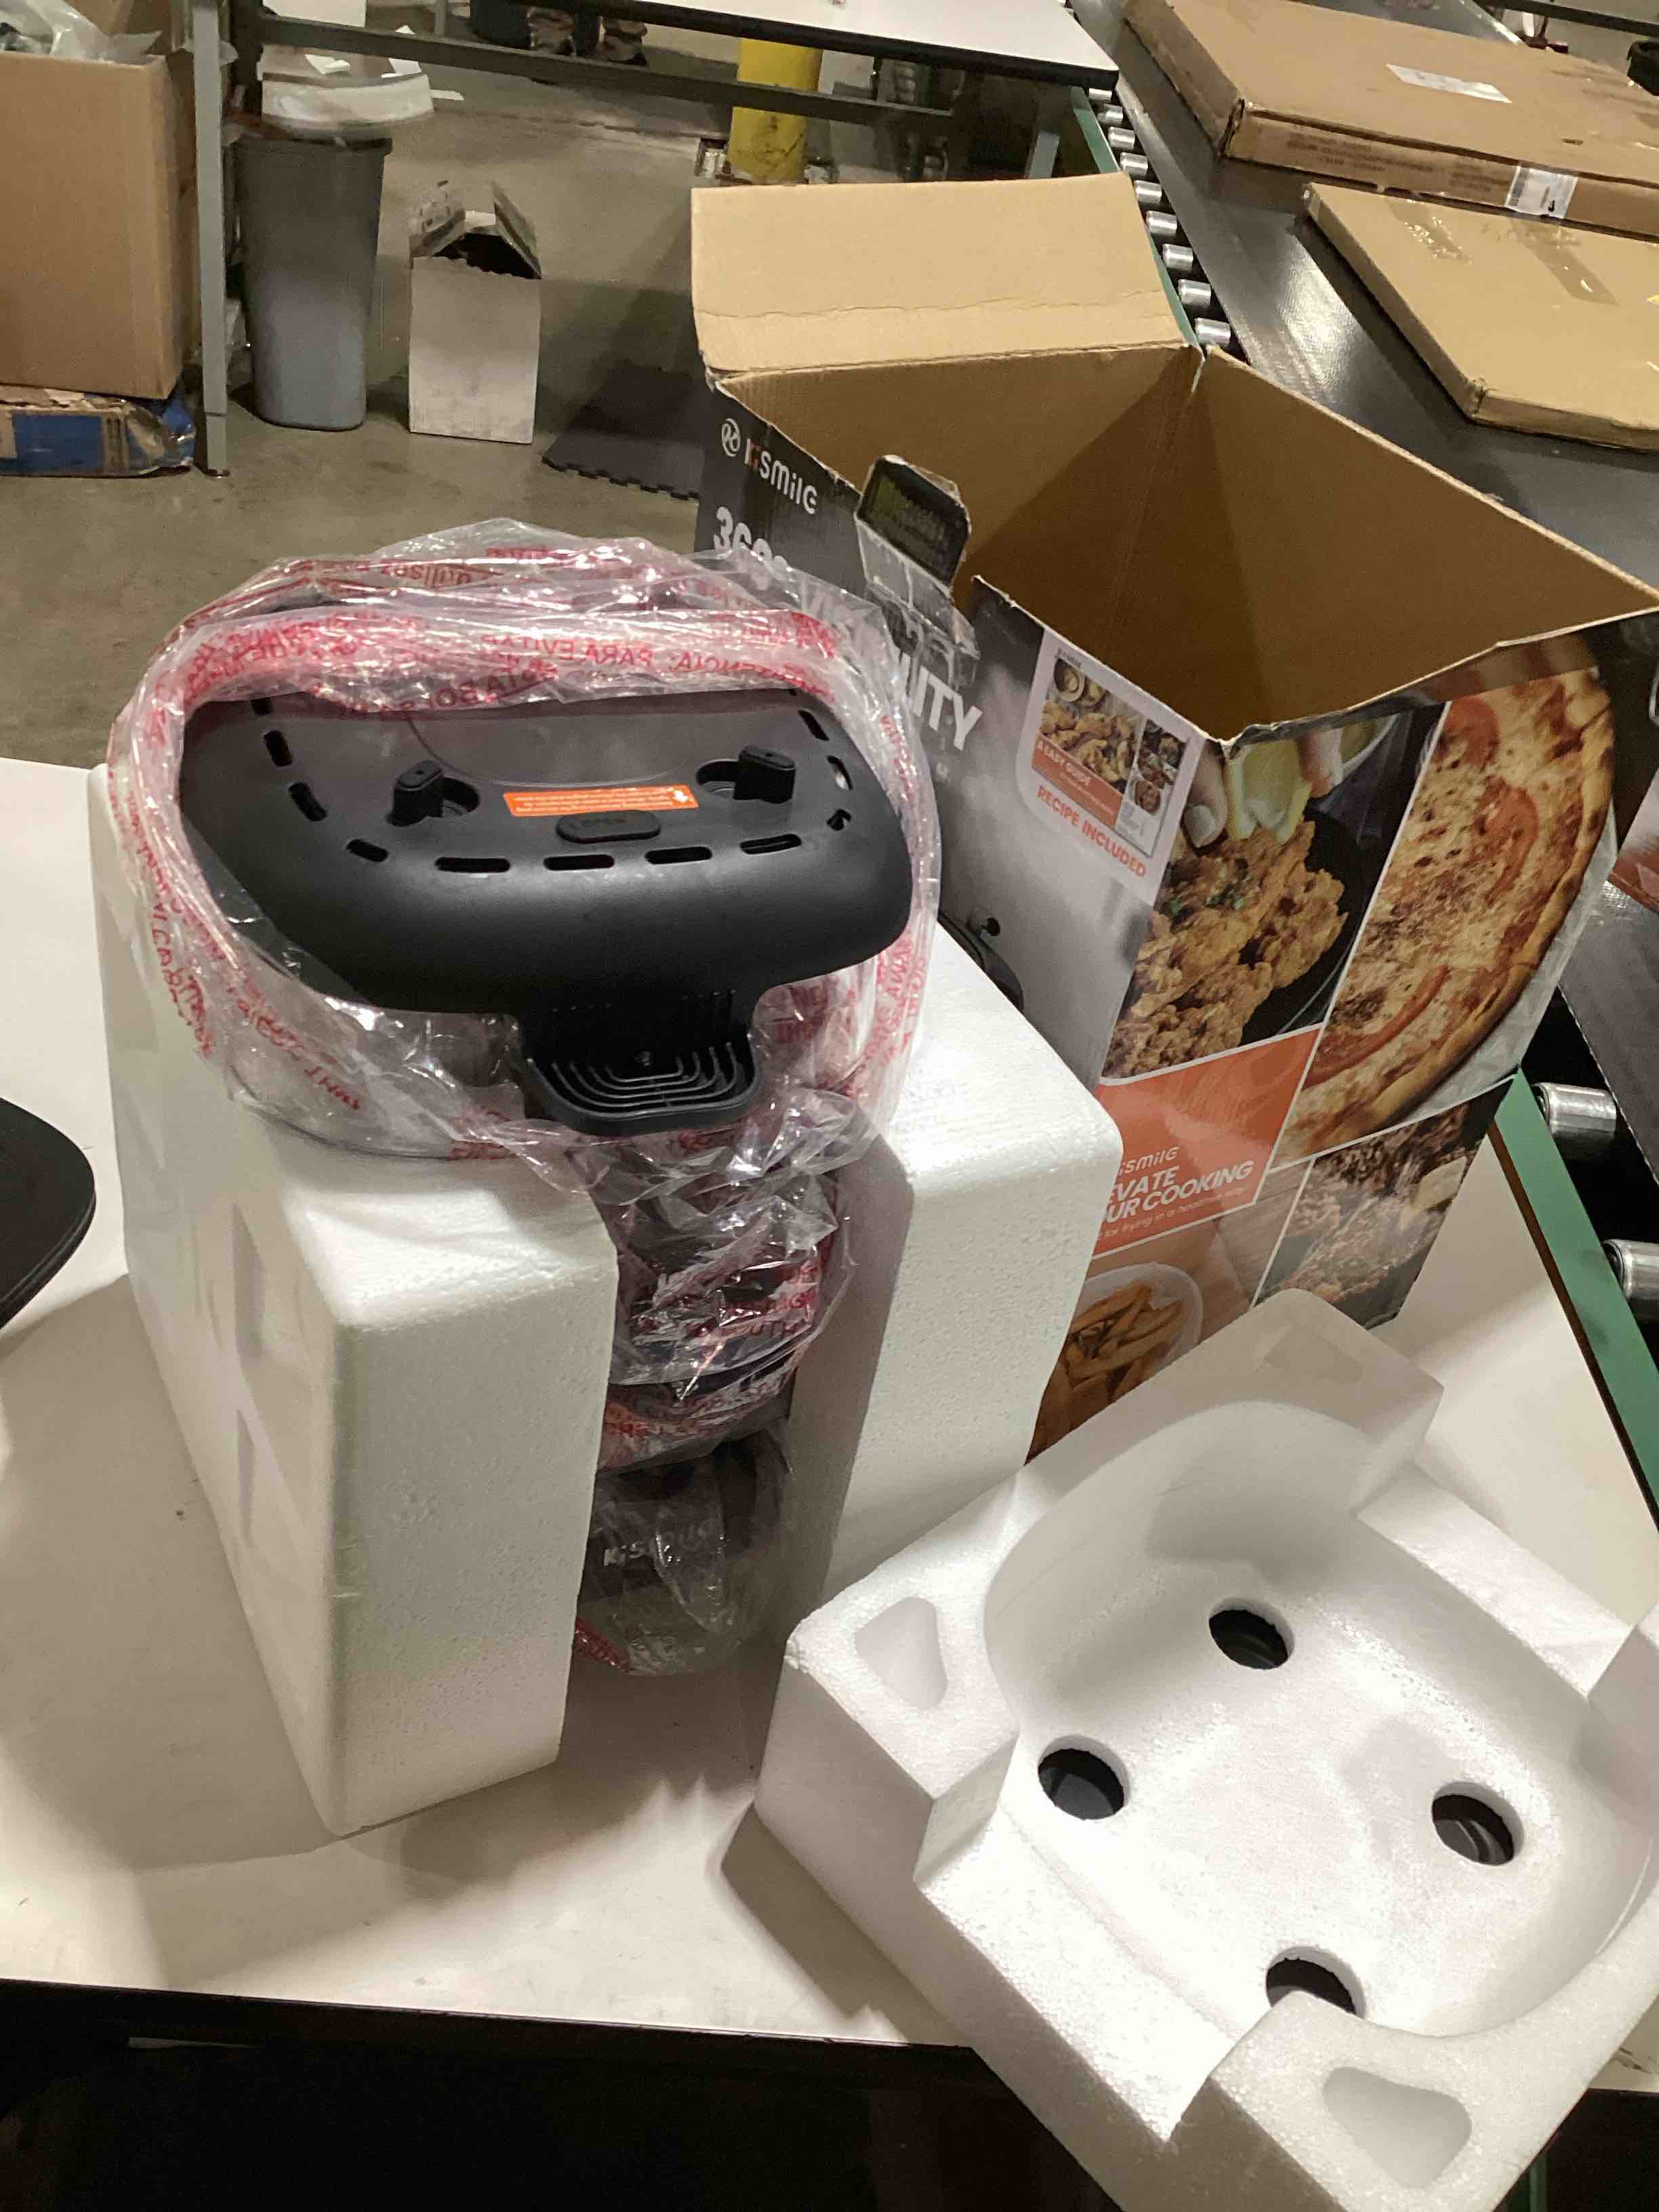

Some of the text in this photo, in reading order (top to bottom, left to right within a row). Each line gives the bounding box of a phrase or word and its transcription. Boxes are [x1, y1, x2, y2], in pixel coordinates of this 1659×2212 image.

[1038, 785, 1080, 827] RECIPE
[1082, 819, 1147, 878] INCLUDED
[1106, 1197, 1141, 1223] UR
[1142, 1160, 1254, 1211] COOKING
